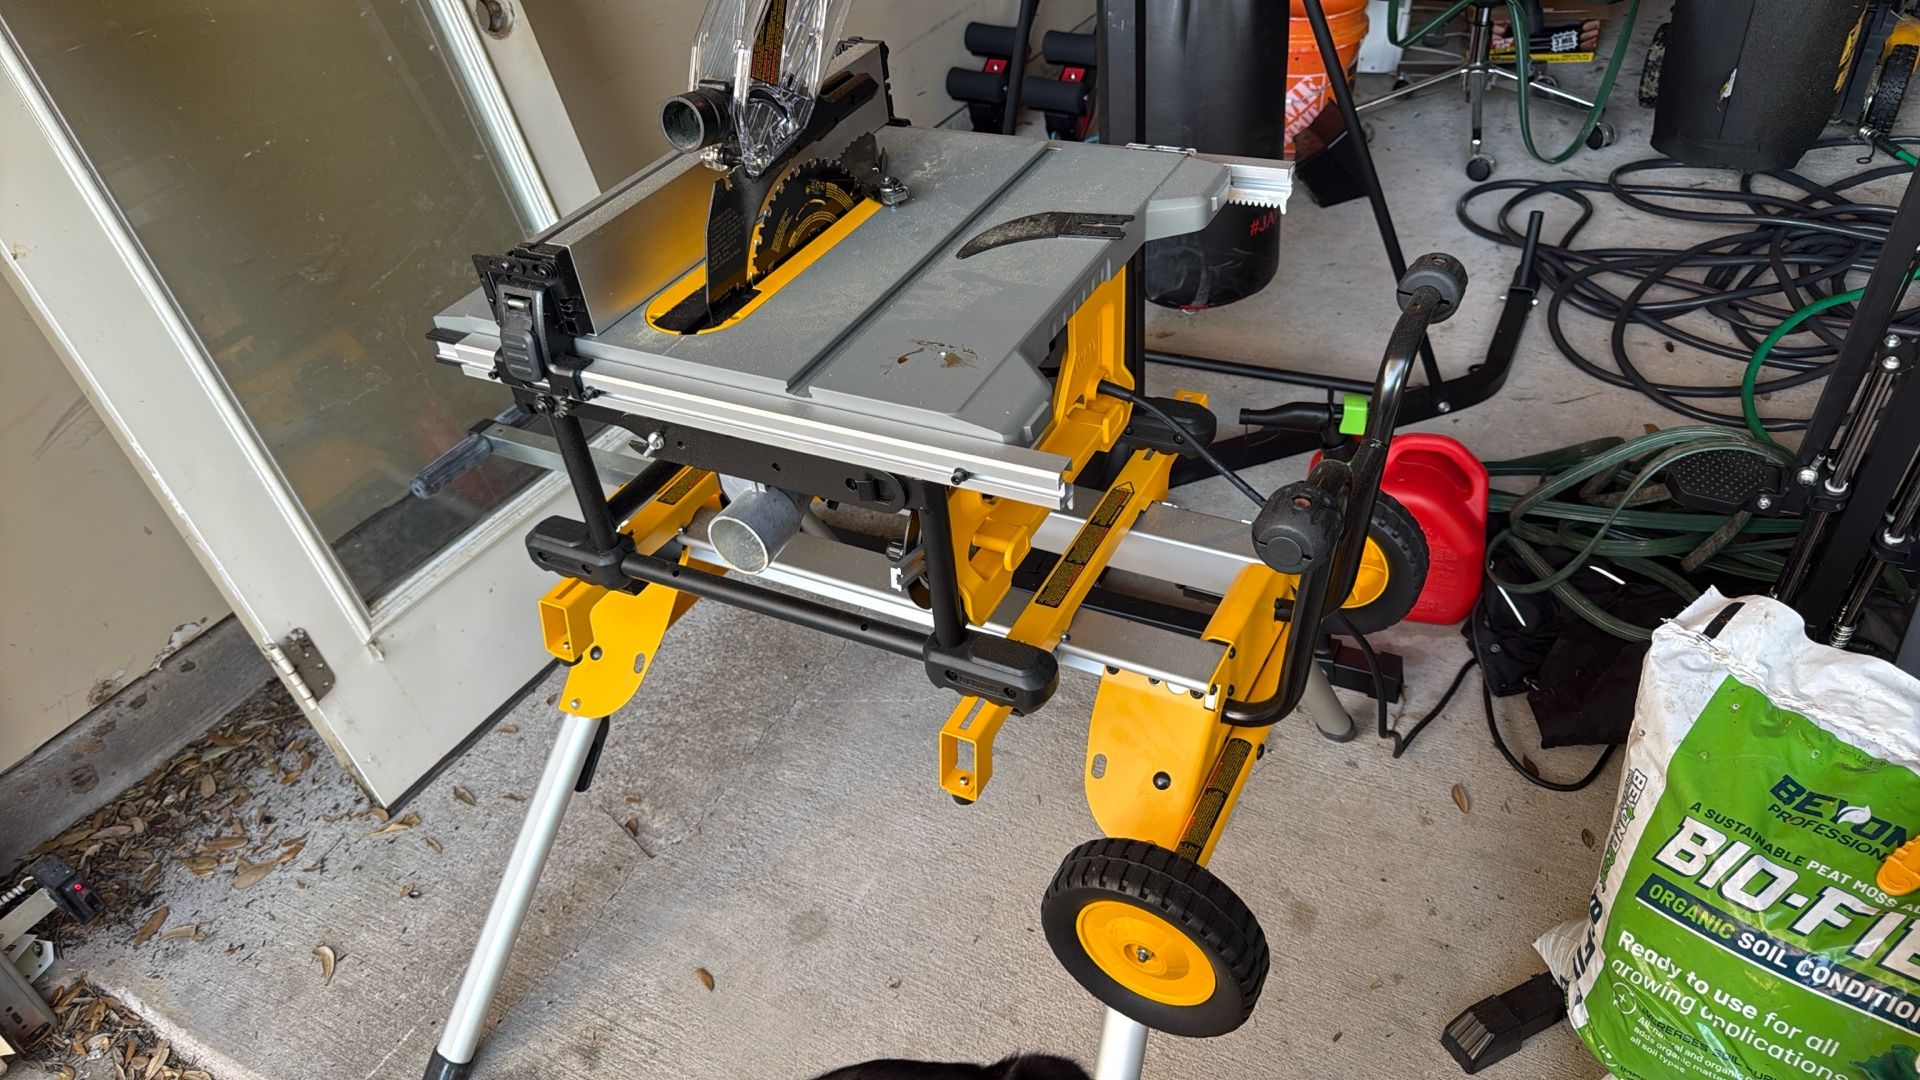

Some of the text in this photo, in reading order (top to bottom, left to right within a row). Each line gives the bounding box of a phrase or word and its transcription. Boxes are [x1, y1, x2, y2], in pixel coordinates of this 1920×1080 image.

[1768, 803, 1888, 861] PROFESSION
[1770, 774, 1906, 848] BEYON
[1690, 802, 1702, 813] A
[1705, 808, 1806, 866] SUSTAINABLE
[1806, 860, 1852, 886] PEAT
[1852, 880, 1898, 908] MOSS
[1649, 884, 1736, 939] ORGANIC
[1738, 932, 1788, 968] SOIL
[1618, 930, 1840, 1058] Ready to use for all
[1630, 1036, 1641, 1046] all
[1641, 1043, 1658, 1057] soil
[1659, 1054, 1687, 1074] types
[1633, 1026, 1655, 1044] adds
[1684, 1050, 1704, 1063] and
